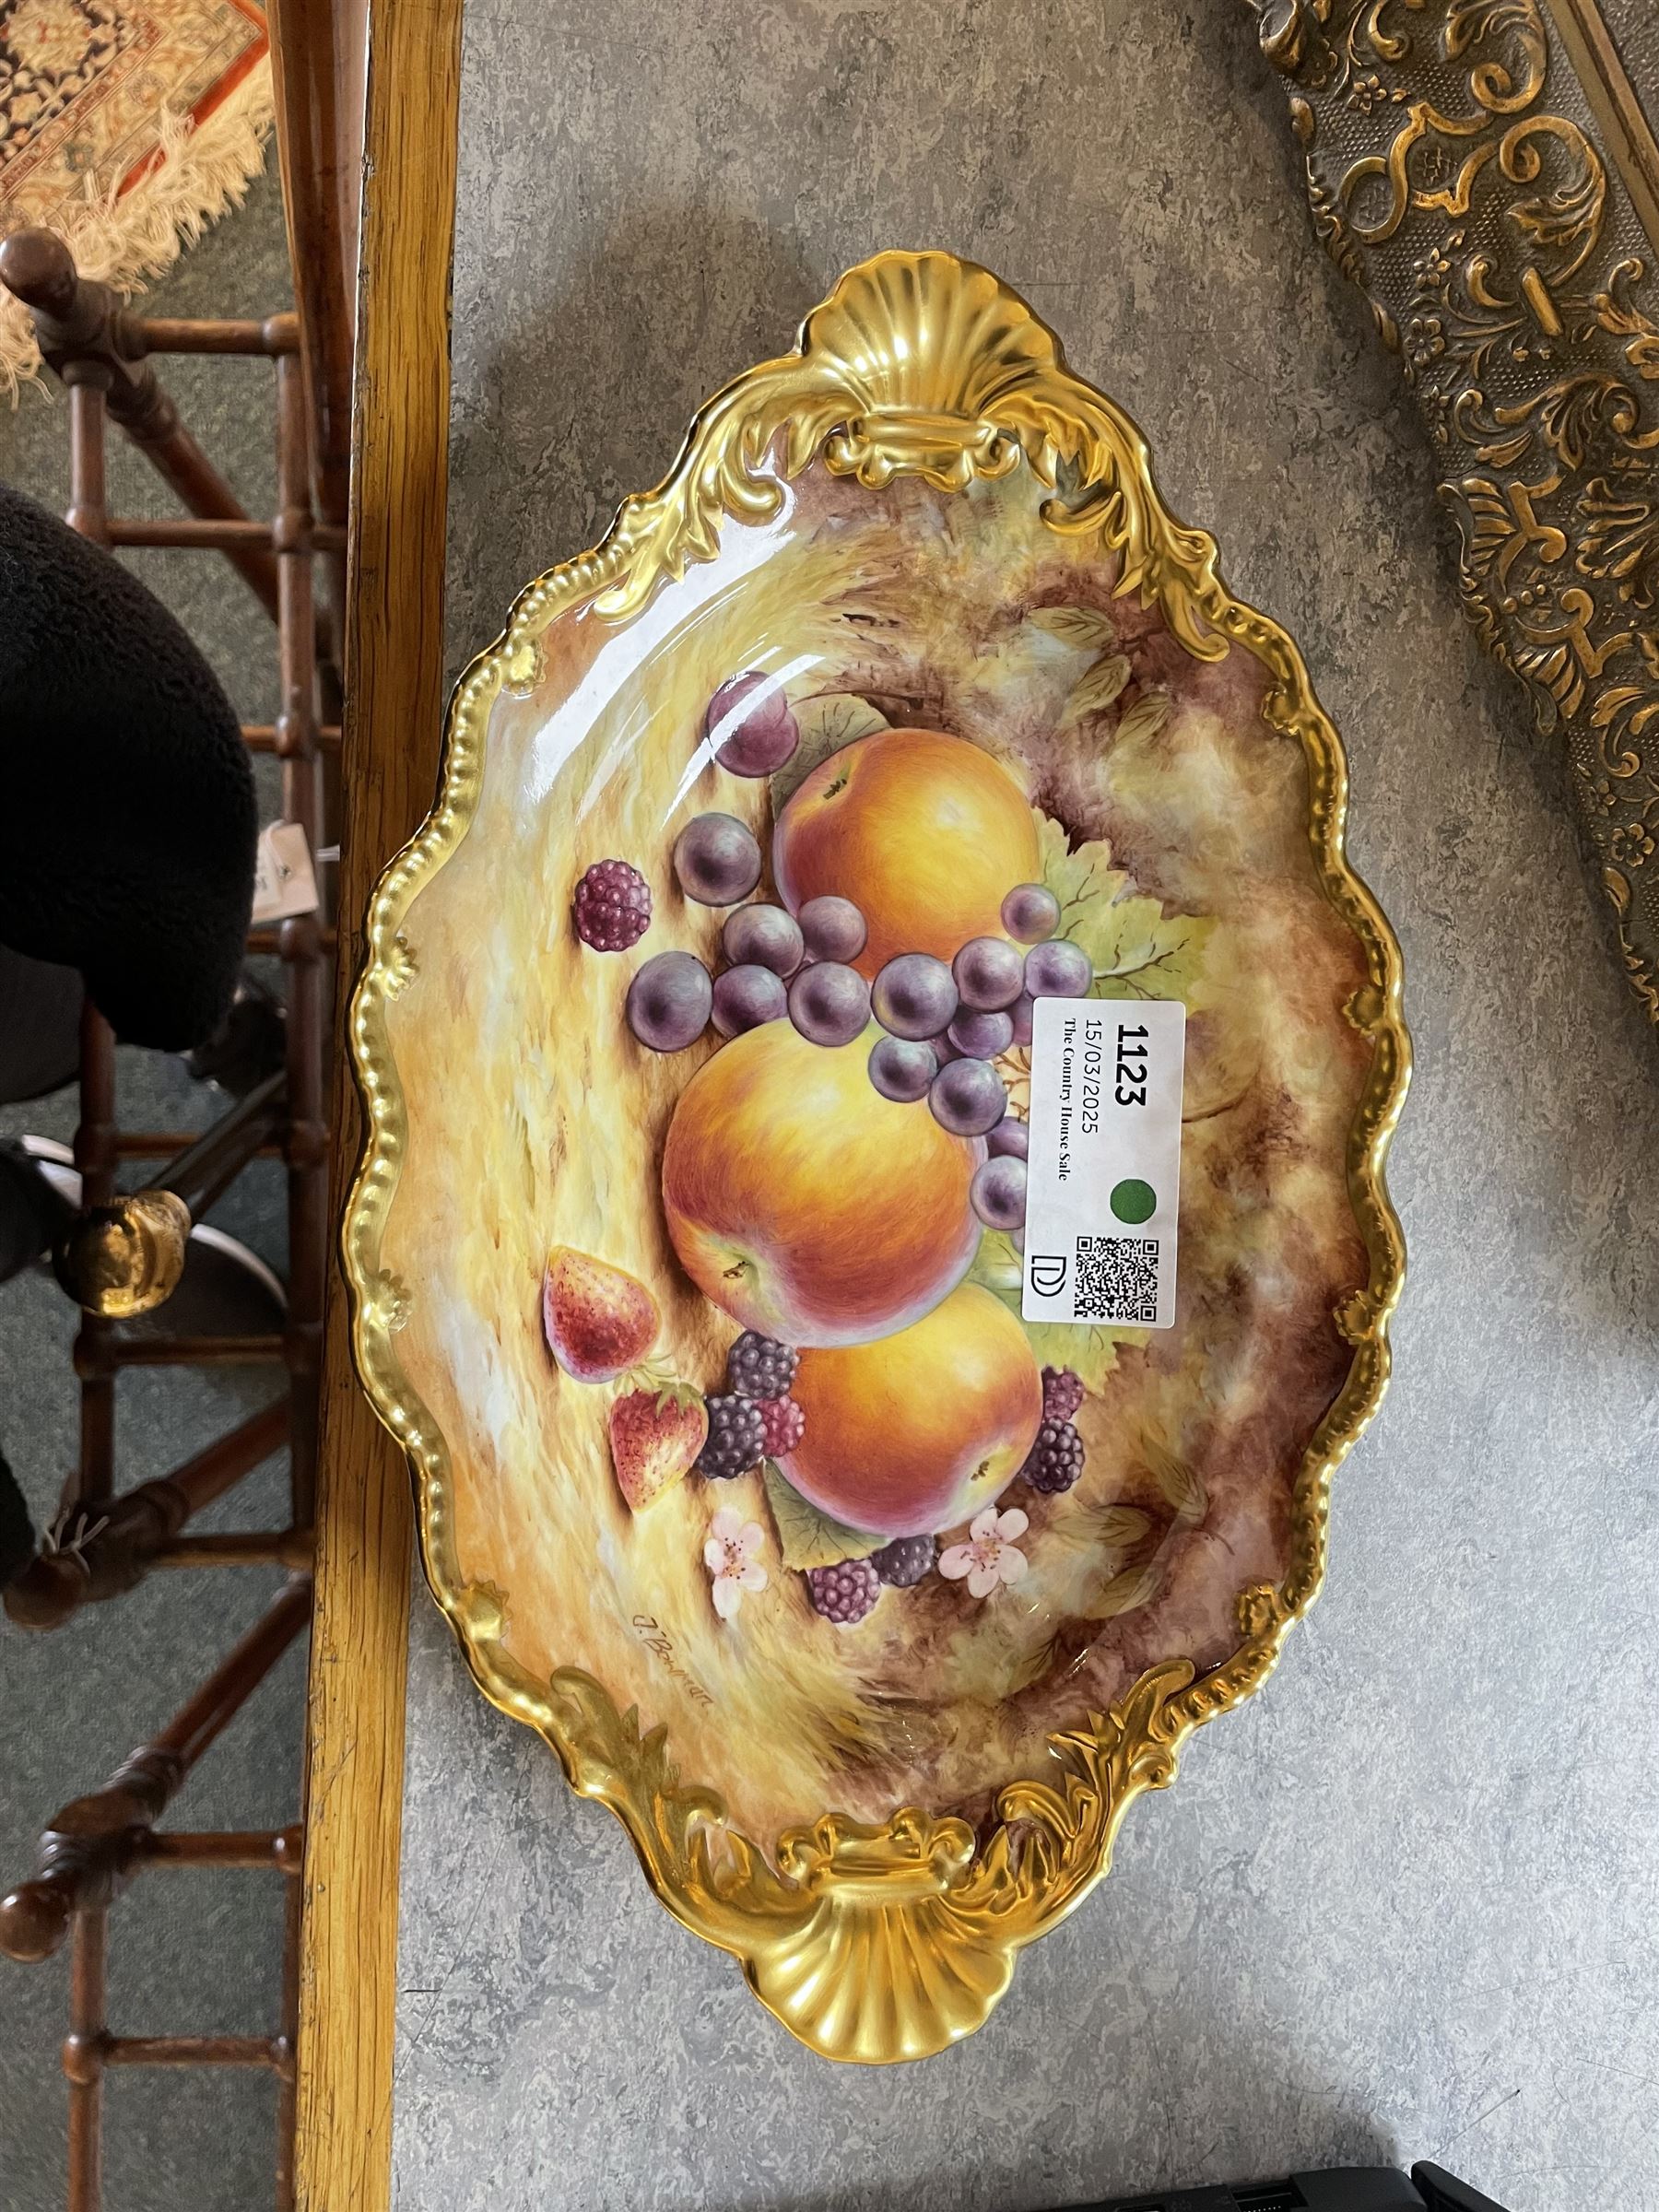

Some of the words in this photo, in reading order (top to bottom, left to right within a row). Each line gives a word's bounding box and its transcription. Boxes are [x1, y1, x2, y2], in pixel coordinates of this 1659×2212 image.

[1064, 1018, 1076, 1044] The
[1059, 1048, 1075, 1102] Country
[1082, 1019, 1102, 1134] 15/03/2025
[1114, 1024, 1149, 1107] 1123
[1060, 1107, 1072, 1149] House
[1058, 1152, 1071, 1181] Sale
